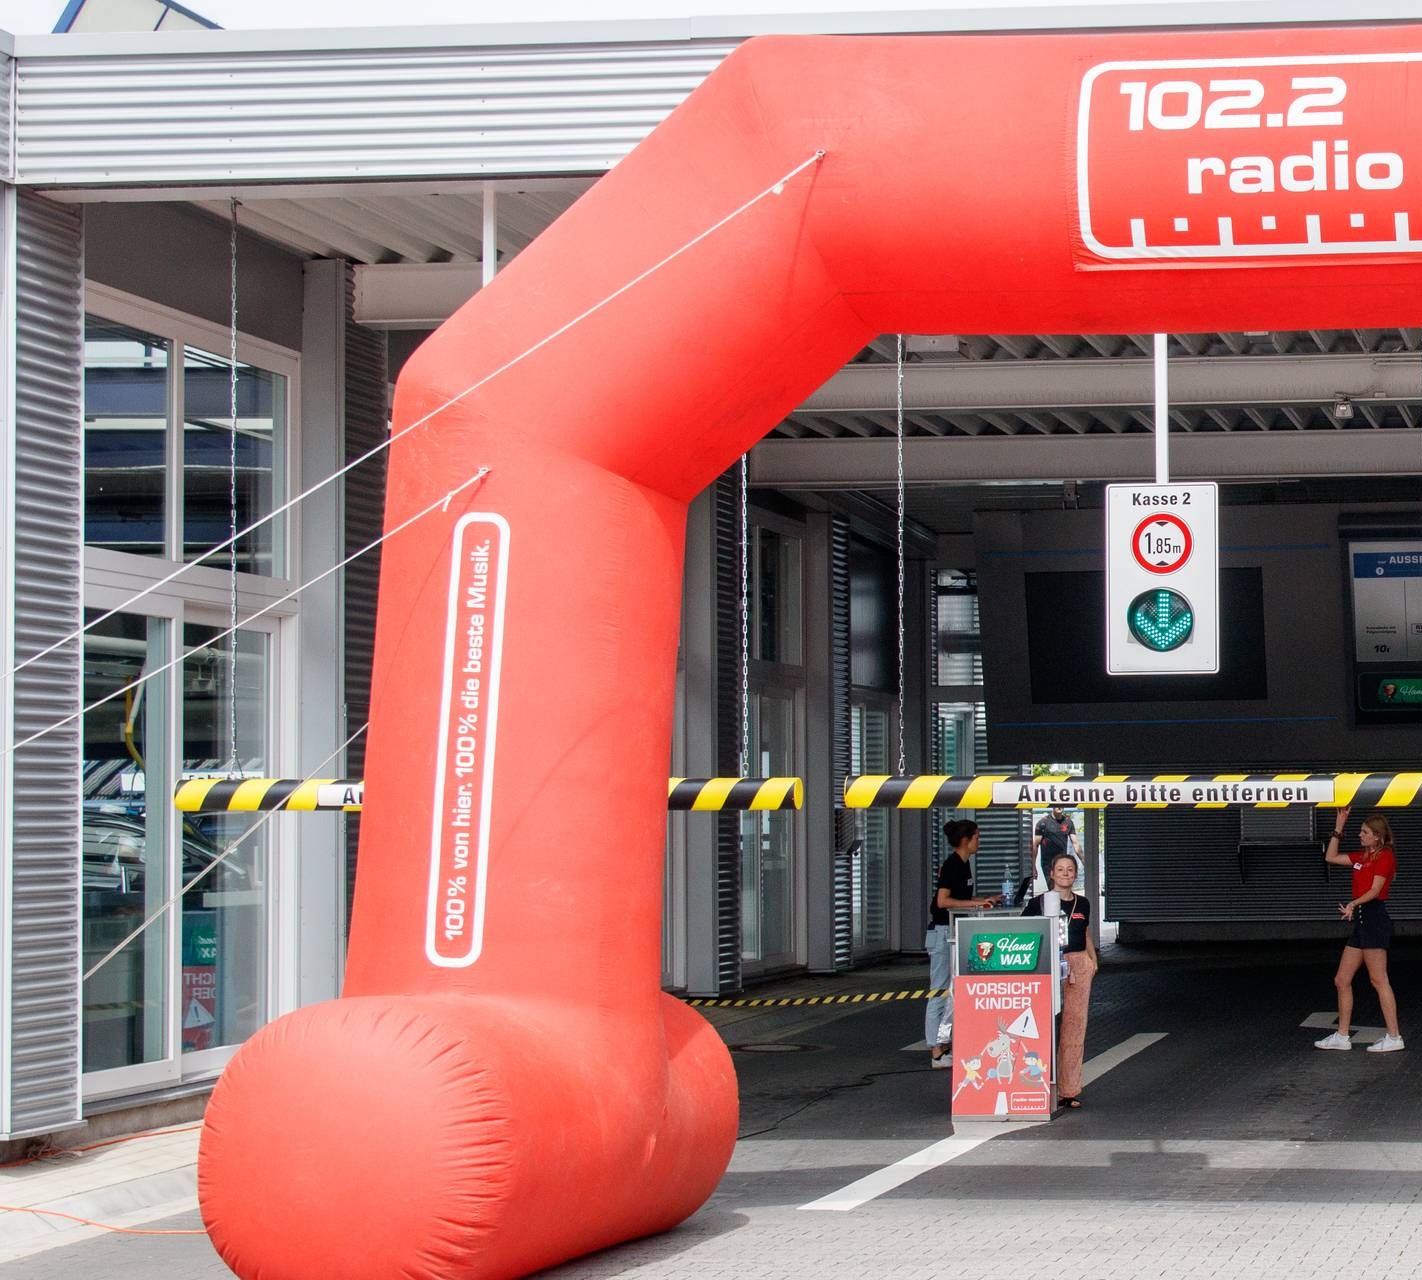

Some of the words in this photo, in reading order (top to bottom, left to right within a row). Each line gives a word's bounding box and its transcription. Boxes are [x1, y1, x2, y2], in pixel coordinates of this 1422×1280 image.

[1119, 76, 1347, 131] 102.2
[1188, 140, 1403, 194] radio
[1132, 492, 1177, 506] Kasse
[1183, 492, 1191, 505] 2
[466, 539, 491, 609] Musik.
[462, 614, 484, 673] beste
[461, 678, 480, 709] die
[452, 782, 473, 827] hier.
[1018, 784, 1114, 802] Antenne
[1126, 784, 1181, 802] bitte
[1192, 783, 1308, 801] entfernen
[454, 832, 470, 869] von
[997, 937, 1035, 952] Hand
[1000, 953, 1032, 965] WAX
[966, 982, 1041, 996] VORSICHT
[974, 996, 1032, 1010] KINDER
